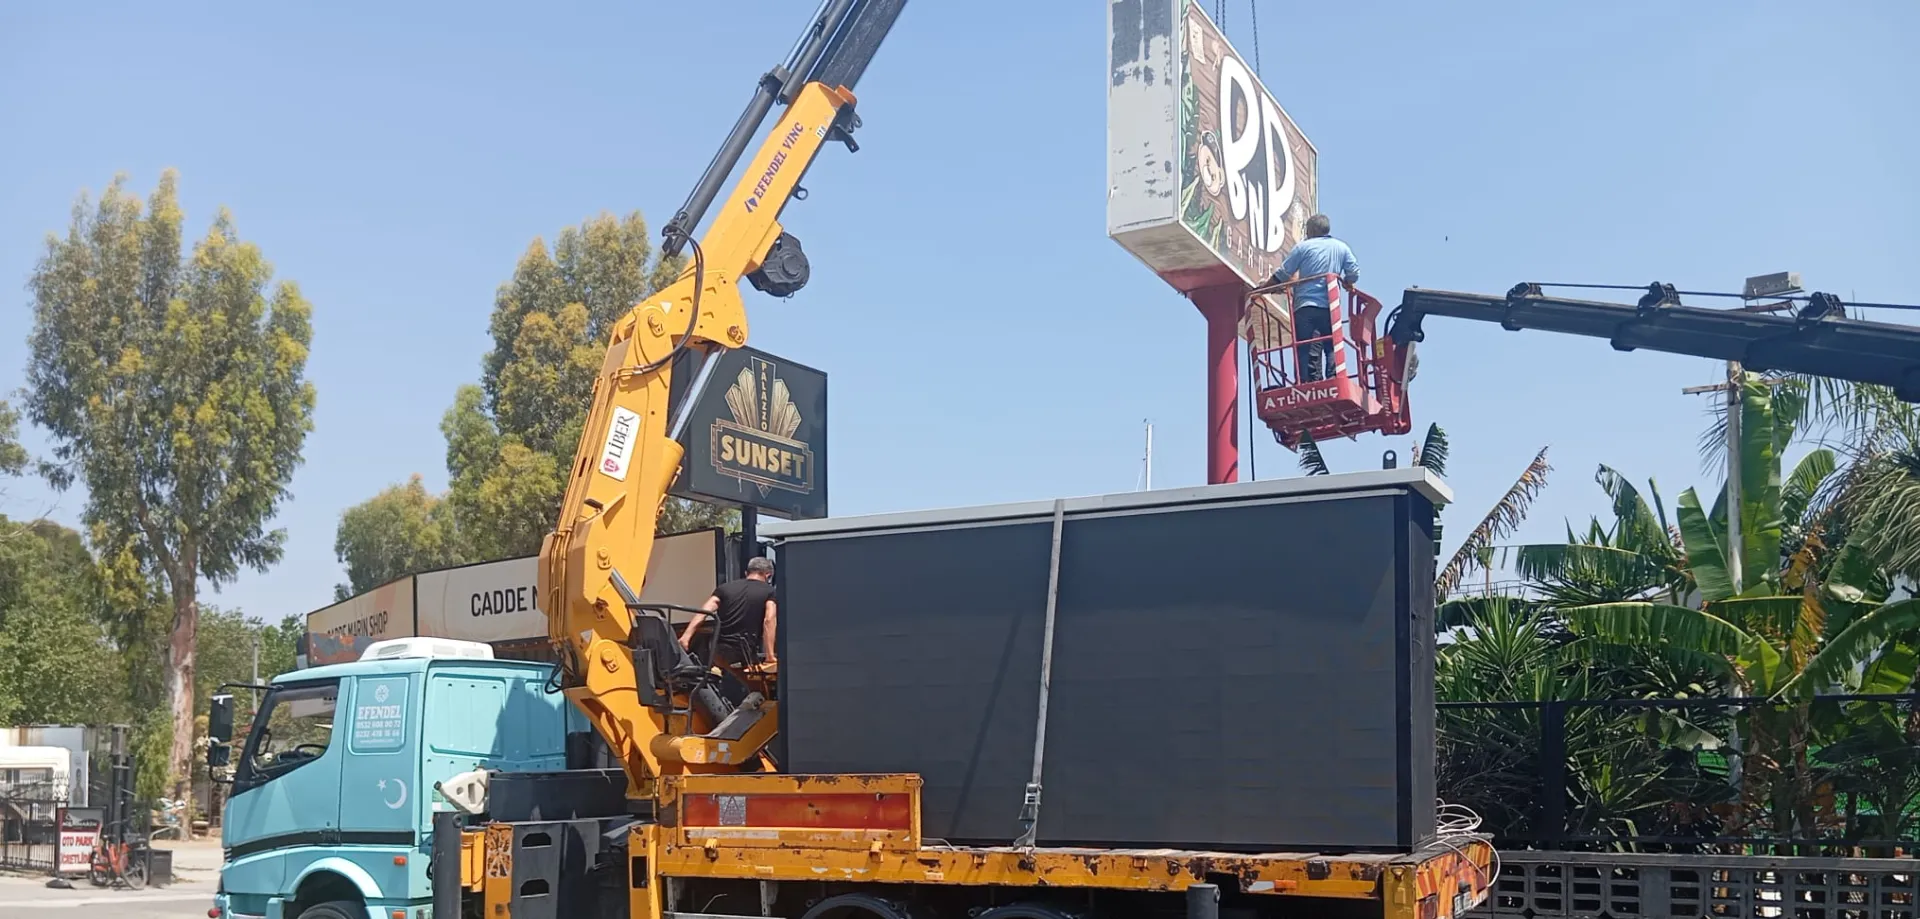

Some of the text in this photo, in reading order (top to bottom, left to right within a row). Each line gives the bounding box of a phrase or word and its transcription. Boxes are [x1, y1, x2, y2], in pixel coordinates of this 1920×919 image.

[753, 150, 787, 199] EFENDEL
[608, 415, 635, 458] LİBER
[721, 435, 804, 479] SUNSET
[471, 587, 527, 617] CADDE
[369, 611, 388, 637] SHOP
[358, 705, 401, 719] EFENDEL
[62, 836, 93, 846] OTO PARK
